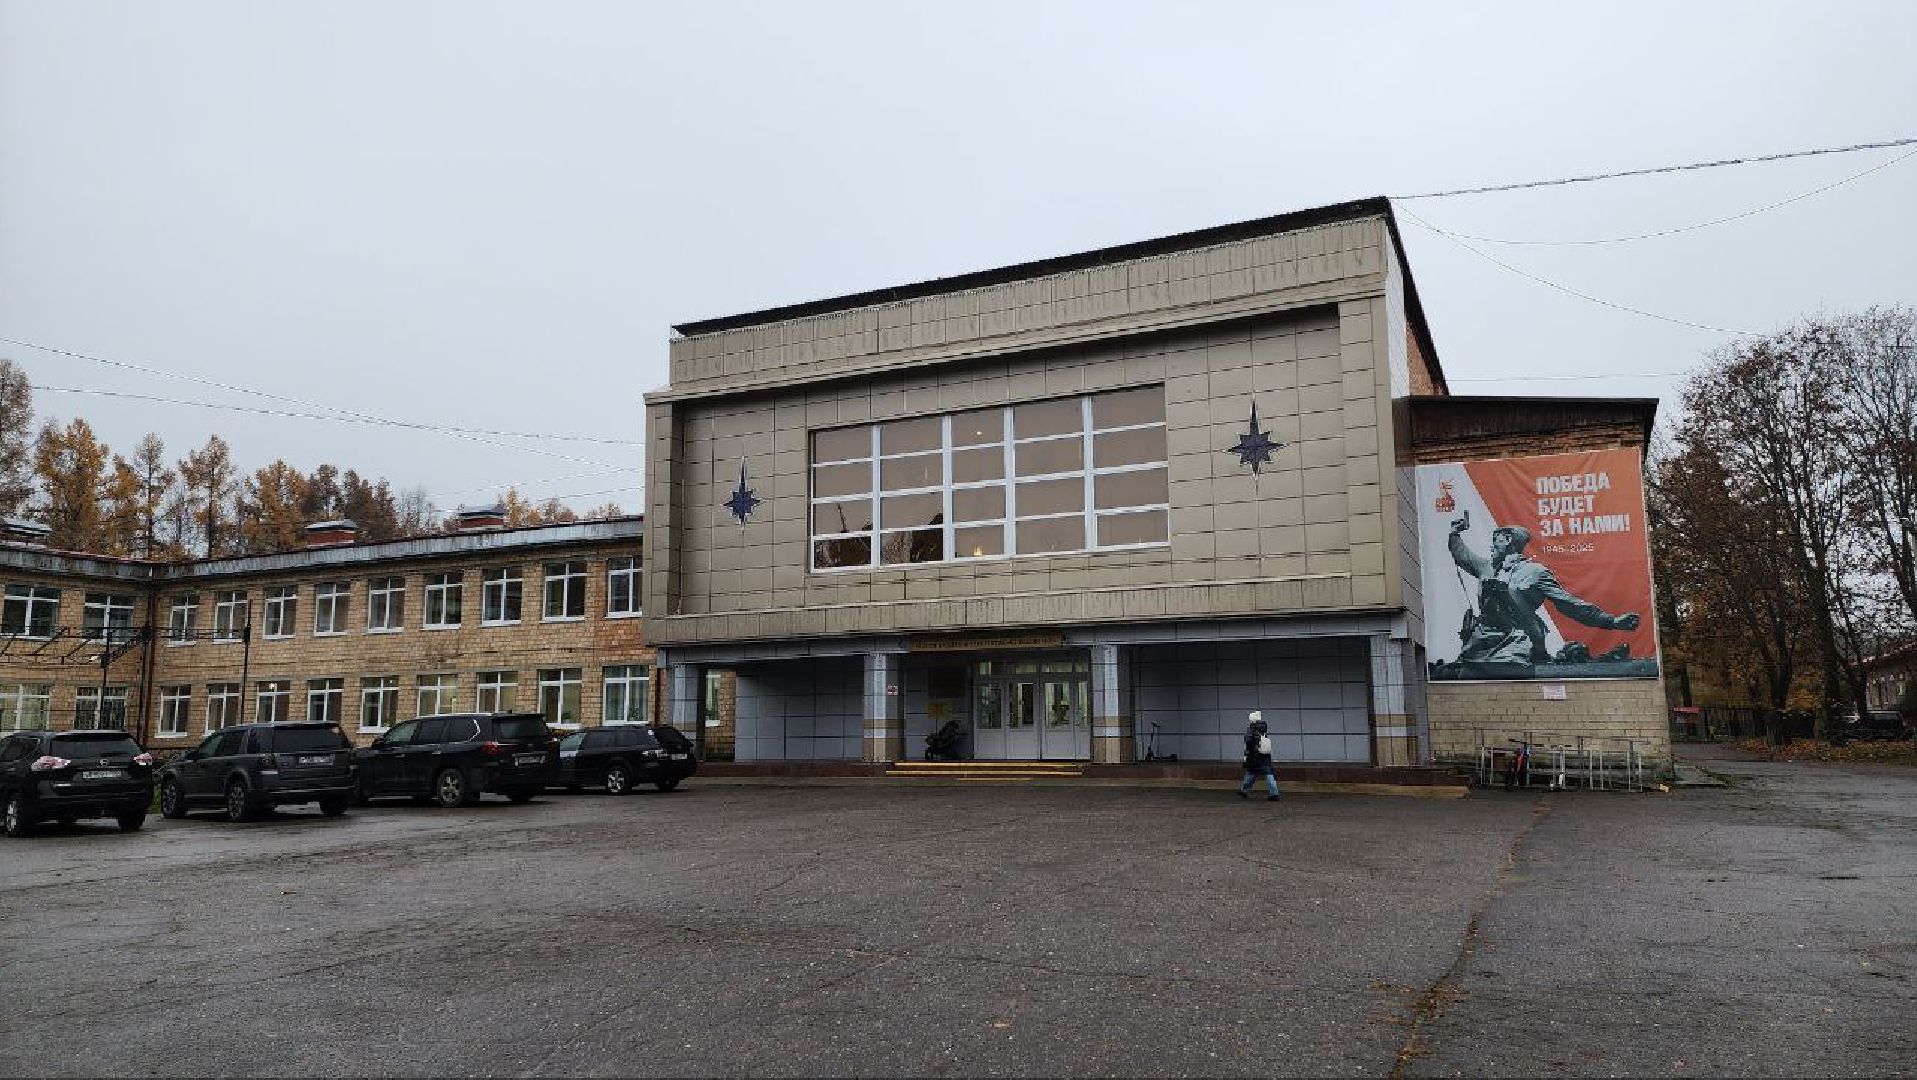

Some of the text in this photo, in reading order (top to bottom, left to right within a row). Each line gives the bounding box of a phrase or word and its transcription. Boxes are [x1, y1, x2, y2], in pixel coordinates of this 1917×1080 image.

[1536, 472, 1611, 494] ПОБЕДА
[1538, 495, 1595, 516] БУДЕТ
[1540, 514, 1630, 536] ЗА НАМИ!
